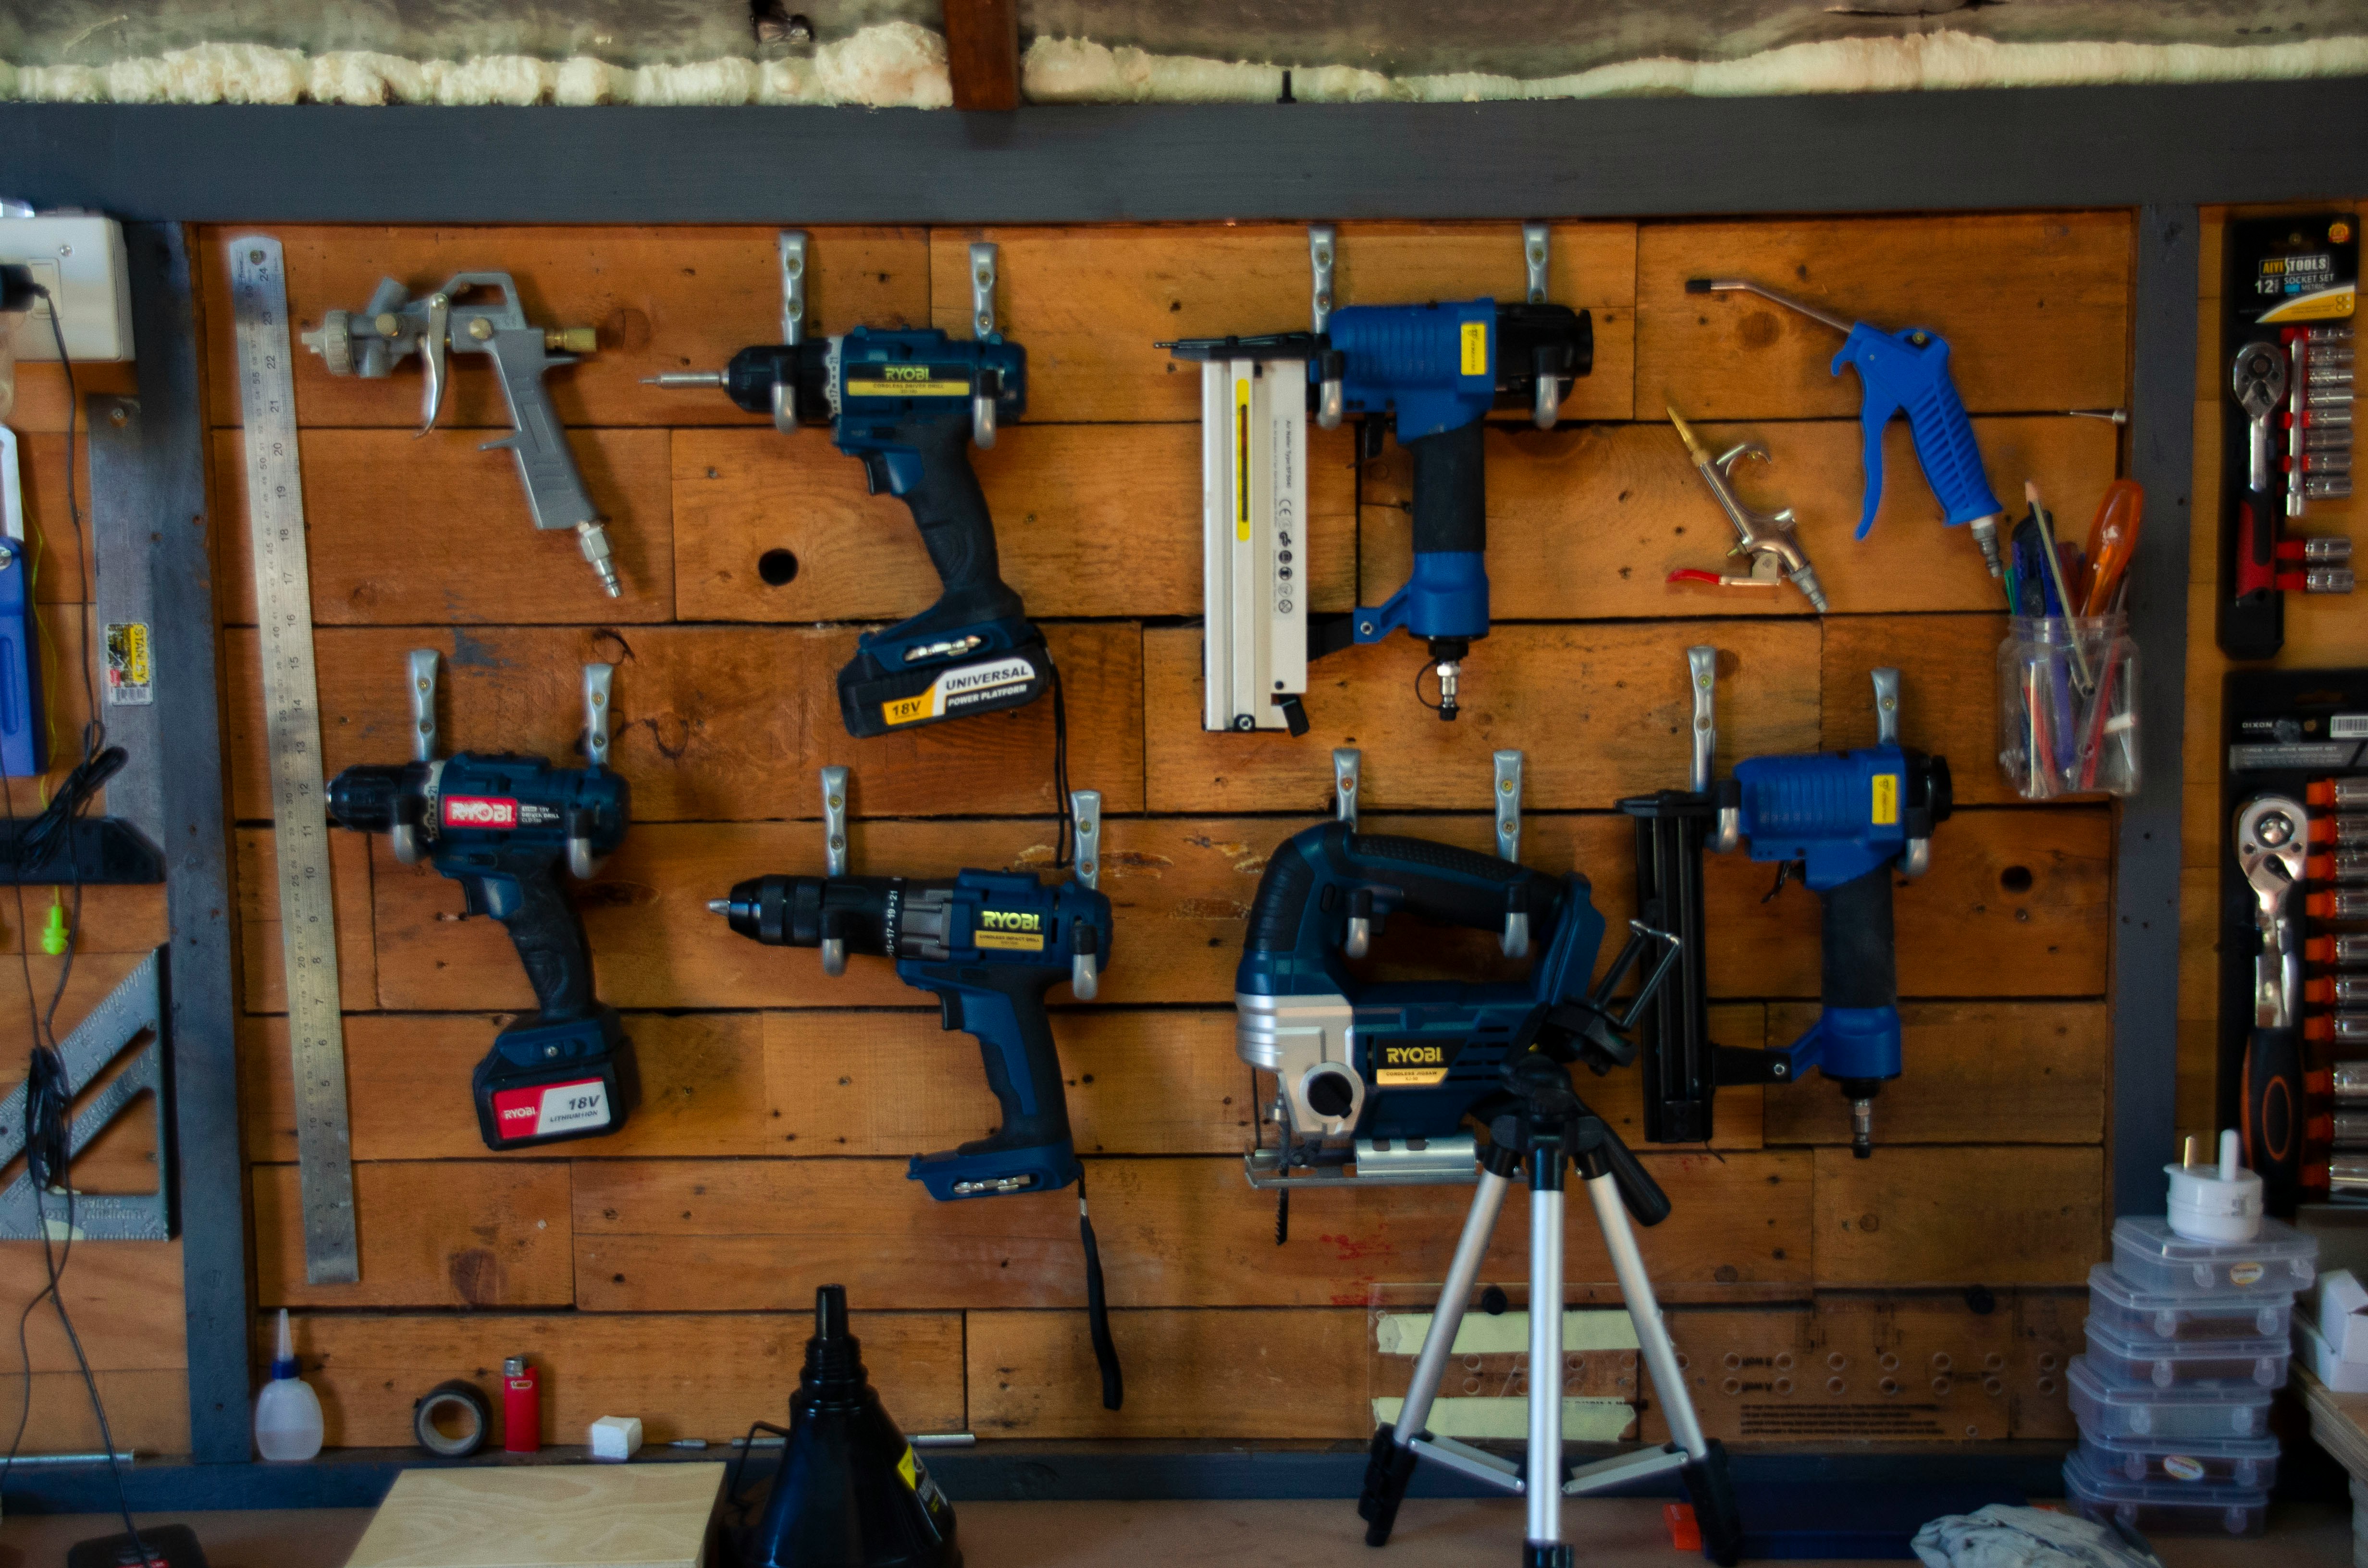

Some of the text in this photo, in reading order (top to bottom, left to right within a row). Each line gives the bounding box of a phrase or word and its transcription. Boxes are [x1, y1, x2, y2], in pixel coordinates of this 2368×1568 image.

[2289, 258, 2326, 271] TOOLS
[259, 268, 268, 281] 24
[2284, 273, 2334, 284] SOCKET SET
[2255, 280, 2274, 294] 12
[263, 312, 271, 325] 23
[251, 340, 256, 349] 57
[252, 357, 257, 365] 56
[267, 355, 275, 369] 22
[253, 372, 260, 384] 55
[885, 367, 929, 381] RYOBI
[829, 390, 838, 398] 17
[257, 408, 261, 416] 53
[270, 400, 279, 412] 21
[258, 426, 263, 434] 52
[273, 443, 283, 456] 20
[260, 457, 267, 469] 50
[262, 477, 267, 485] 49
[276, 486, 285, 498] 19
[265, 511, 270, 519] 47
[266, 527, 271, 536] 46
[280, 529, 288, 541] 18
[266, 543, 273, 554] 45
[270, 562, 273, 570] 44
[270, 578, 275, 587] 43
[284, 572, 292, 585] 17
[272, 595, 276, 603] 42
[287, 614, 296, 627] 16
[273, 627, 280, 638] 40
[277, 662, 282, 670] 38
[290, 657, 299, 670] 15
[279, 678, 283, 686] 37
[946, 665, 1029, 691] UNIVERSAL
[279, 695, 284, 703] 36
[948, 684, 1027, 708] POWER PLATFORM
[294, 699, 302, 711] 14
[891, 701, 922, 716] 18V
[279, 710, 286, 722] 35
[296, 742, 305, 754] 13
[300, 784, 308, 796] 12
[428, 785, 437, 794] 21
[286, 793, 293, 804] 30
[288, 811, 293, 819] 29
[452, 802, 512, 822] RYOBI
[290, 827, 294, 835] 28
[303, 825, 311, 836] 11
[292, 860, 296, 869] 26
[306, 867, 315, 879] 10
[292, 875, 299, 886] 25
[886, 890, 898, 953] 15 17 19 21
[981, 911, 1040, 931] RYOBI
[297, 926, 301, 934] 22
[298, 957, 305, 968] 20
[304, 1038, 311, 1048] 15
[1386, 1047, 1443, 1063] RYOBI
[569, 1094, 601, 1111] 18V
[503, 1106, 536, 1120] RYOBI
[310, 1117, 317, 1128] 10
